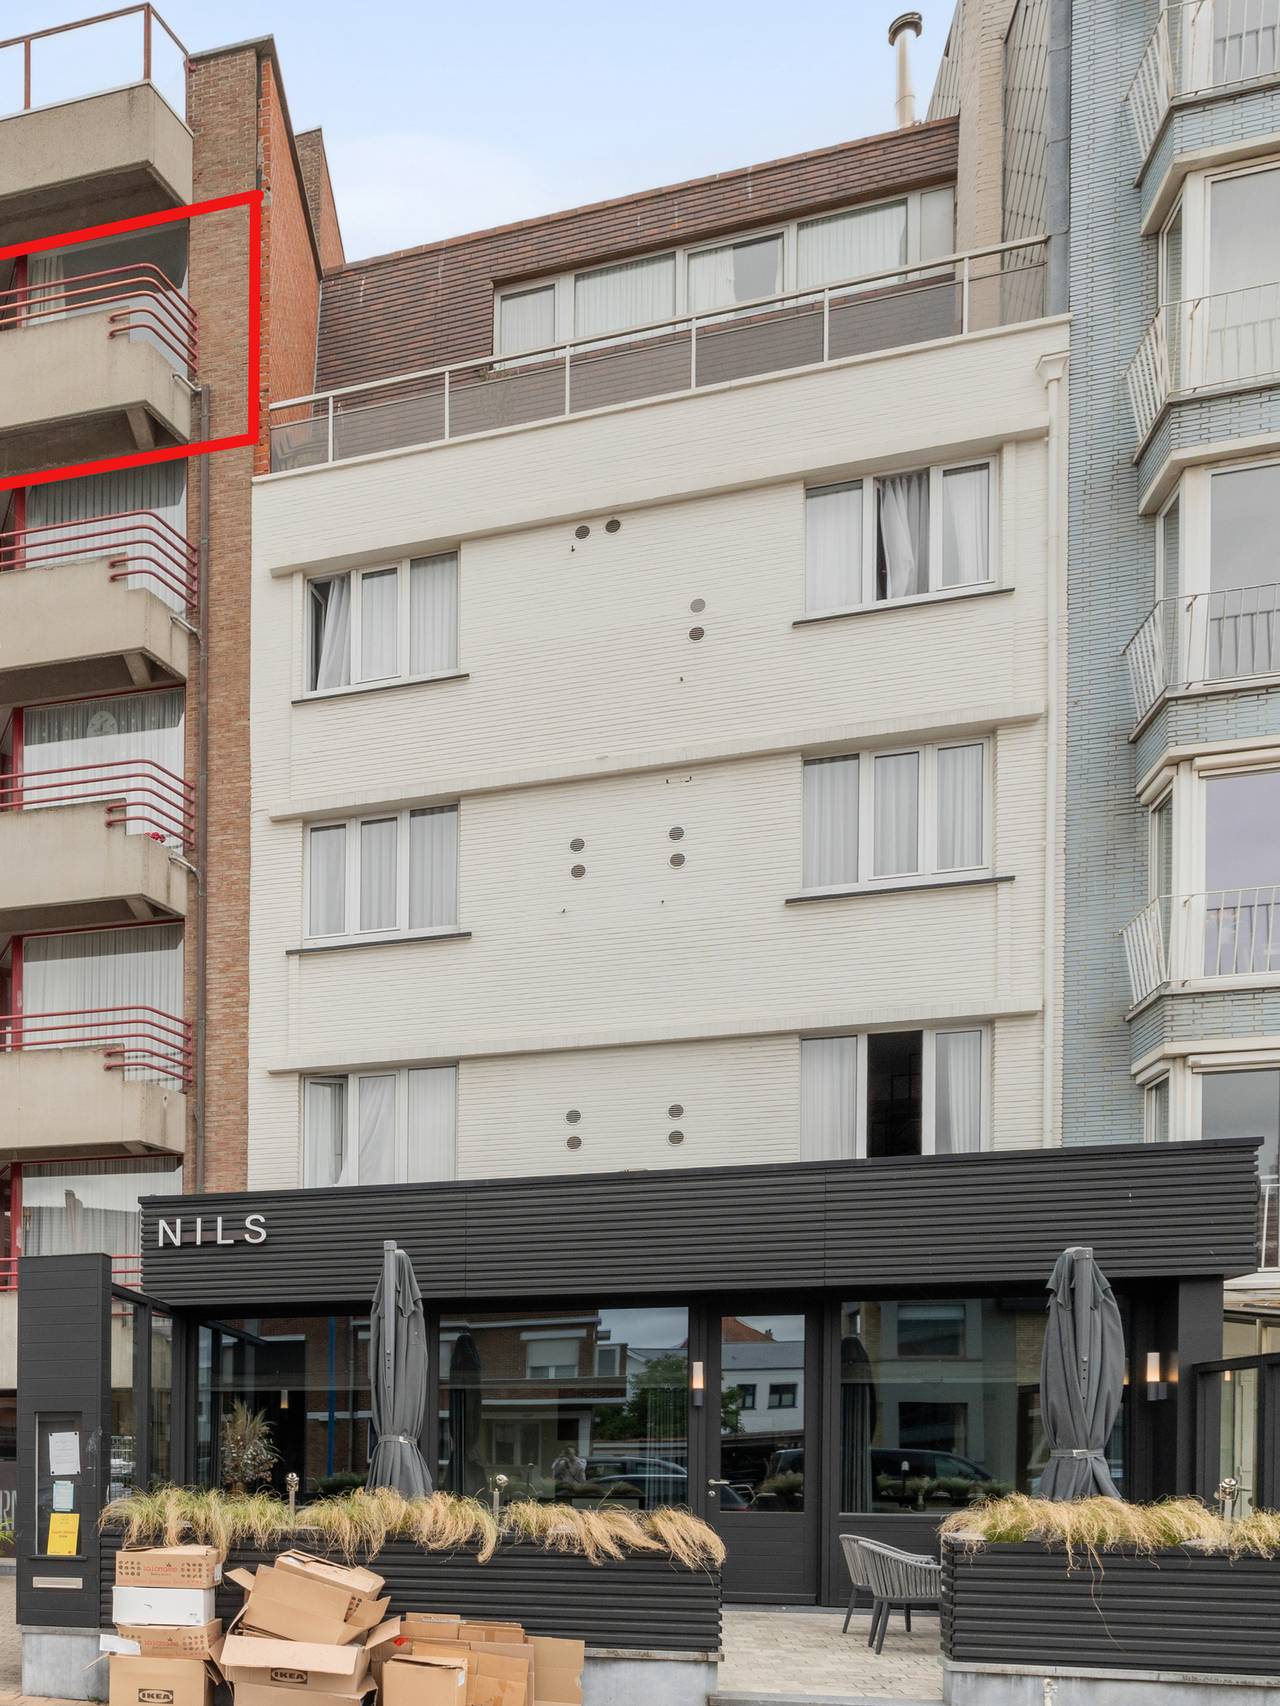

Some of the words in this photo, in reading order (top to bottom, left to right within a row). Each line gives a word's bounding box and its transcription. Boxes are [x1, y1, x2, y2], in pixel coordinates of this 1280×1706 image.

[158, 1214, 267, 1247] NILS
[274, 1671, 305, 1681] IKEA
[141, 1692, 171, 1700] IKEA
